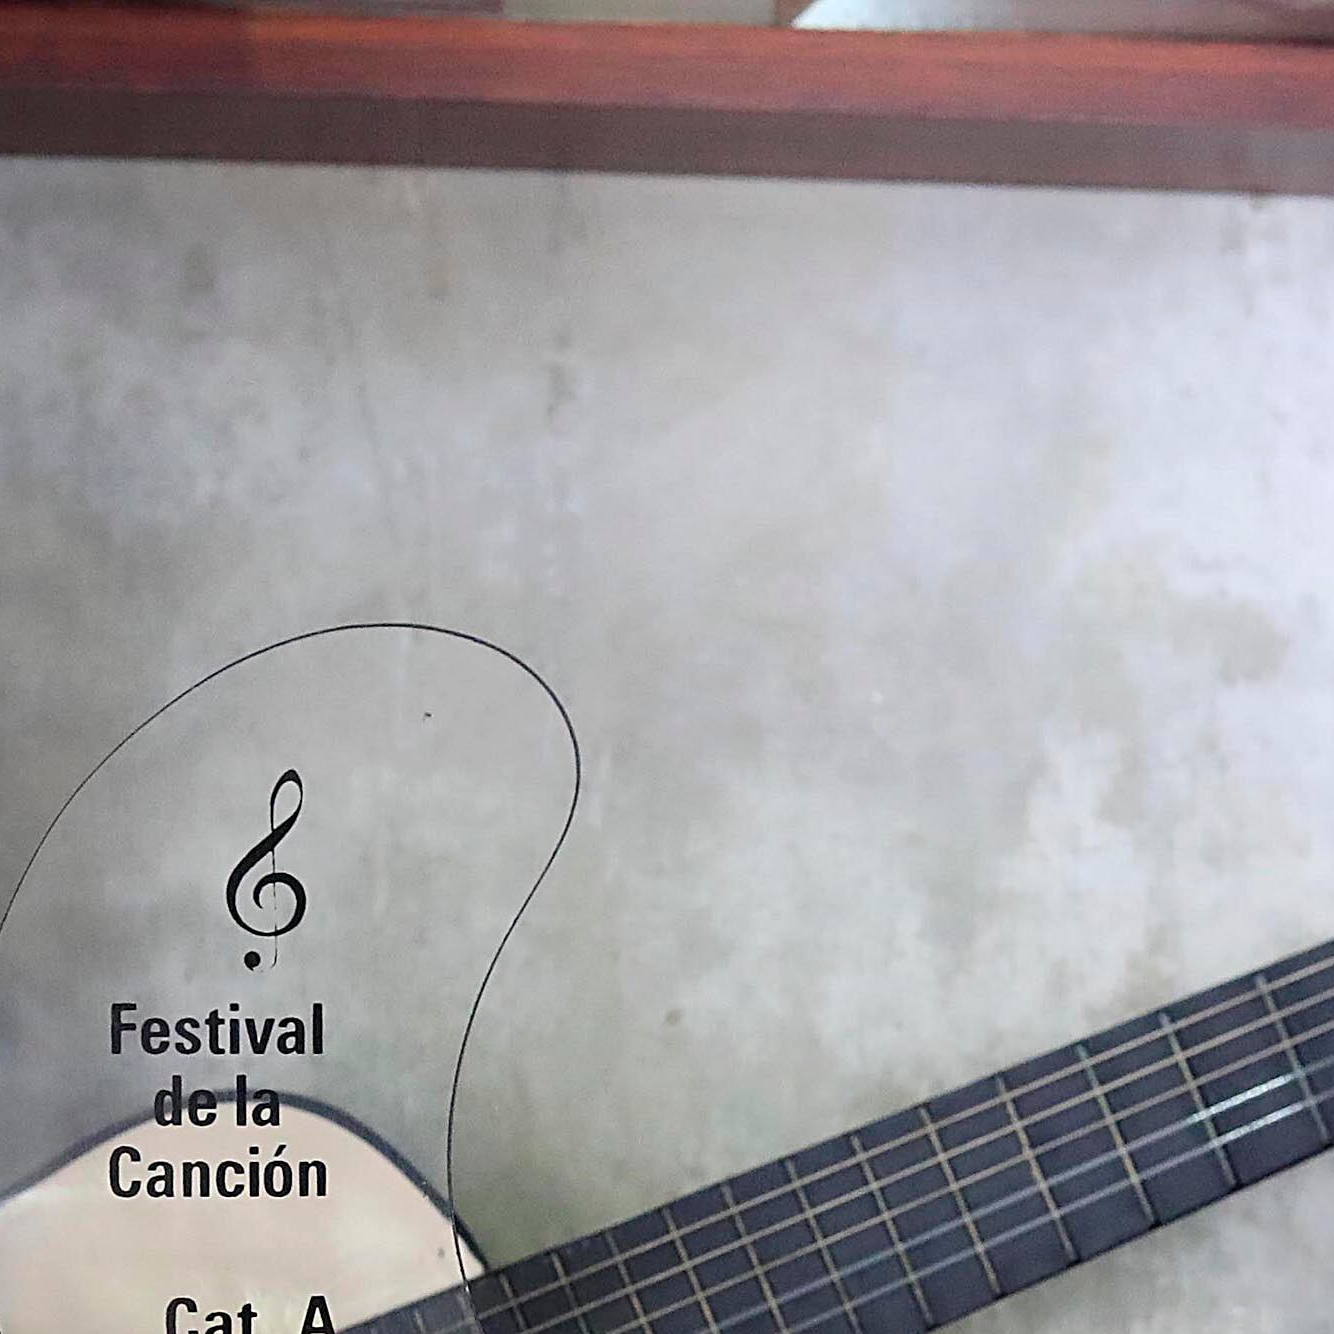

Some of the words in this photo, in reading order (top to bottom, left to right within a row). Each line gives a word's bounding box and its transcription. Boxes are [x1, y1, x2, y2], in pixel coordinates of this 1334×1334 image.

[110, 1002, 325, 1055] Festival
[154, 1075, 217, 1128] de
[236, 1075, 281, 1128] la
[109, 1144, 328, 1198] Canción
